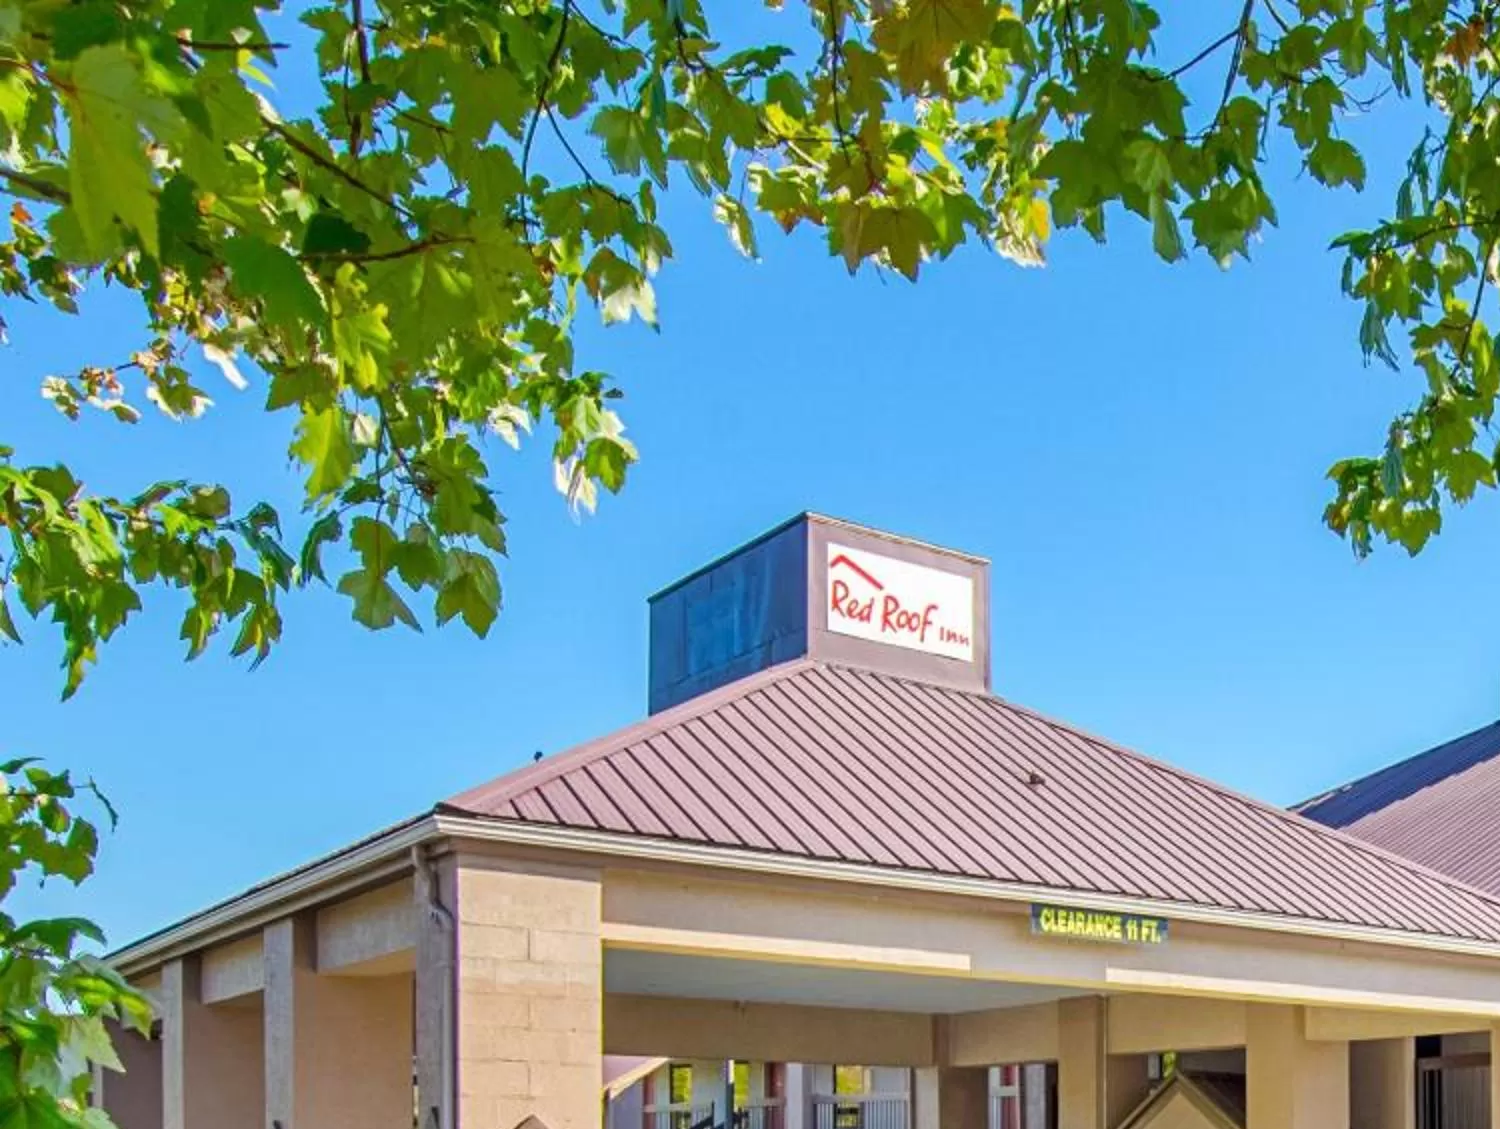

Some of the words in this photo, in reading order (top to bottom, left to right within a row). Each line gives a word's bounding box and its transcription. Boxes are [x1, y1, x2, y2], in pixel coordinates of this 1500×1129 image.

[831, 579, 875, 624] Red
[881, 594, 938, 643] Roof
[938, 626, 970, 647] Inn
[1040, 907, 1123, 939] CLEARANCE
[1126, 919, 1138, 941] 11
[1141, 919, 1162, 944] FT.
